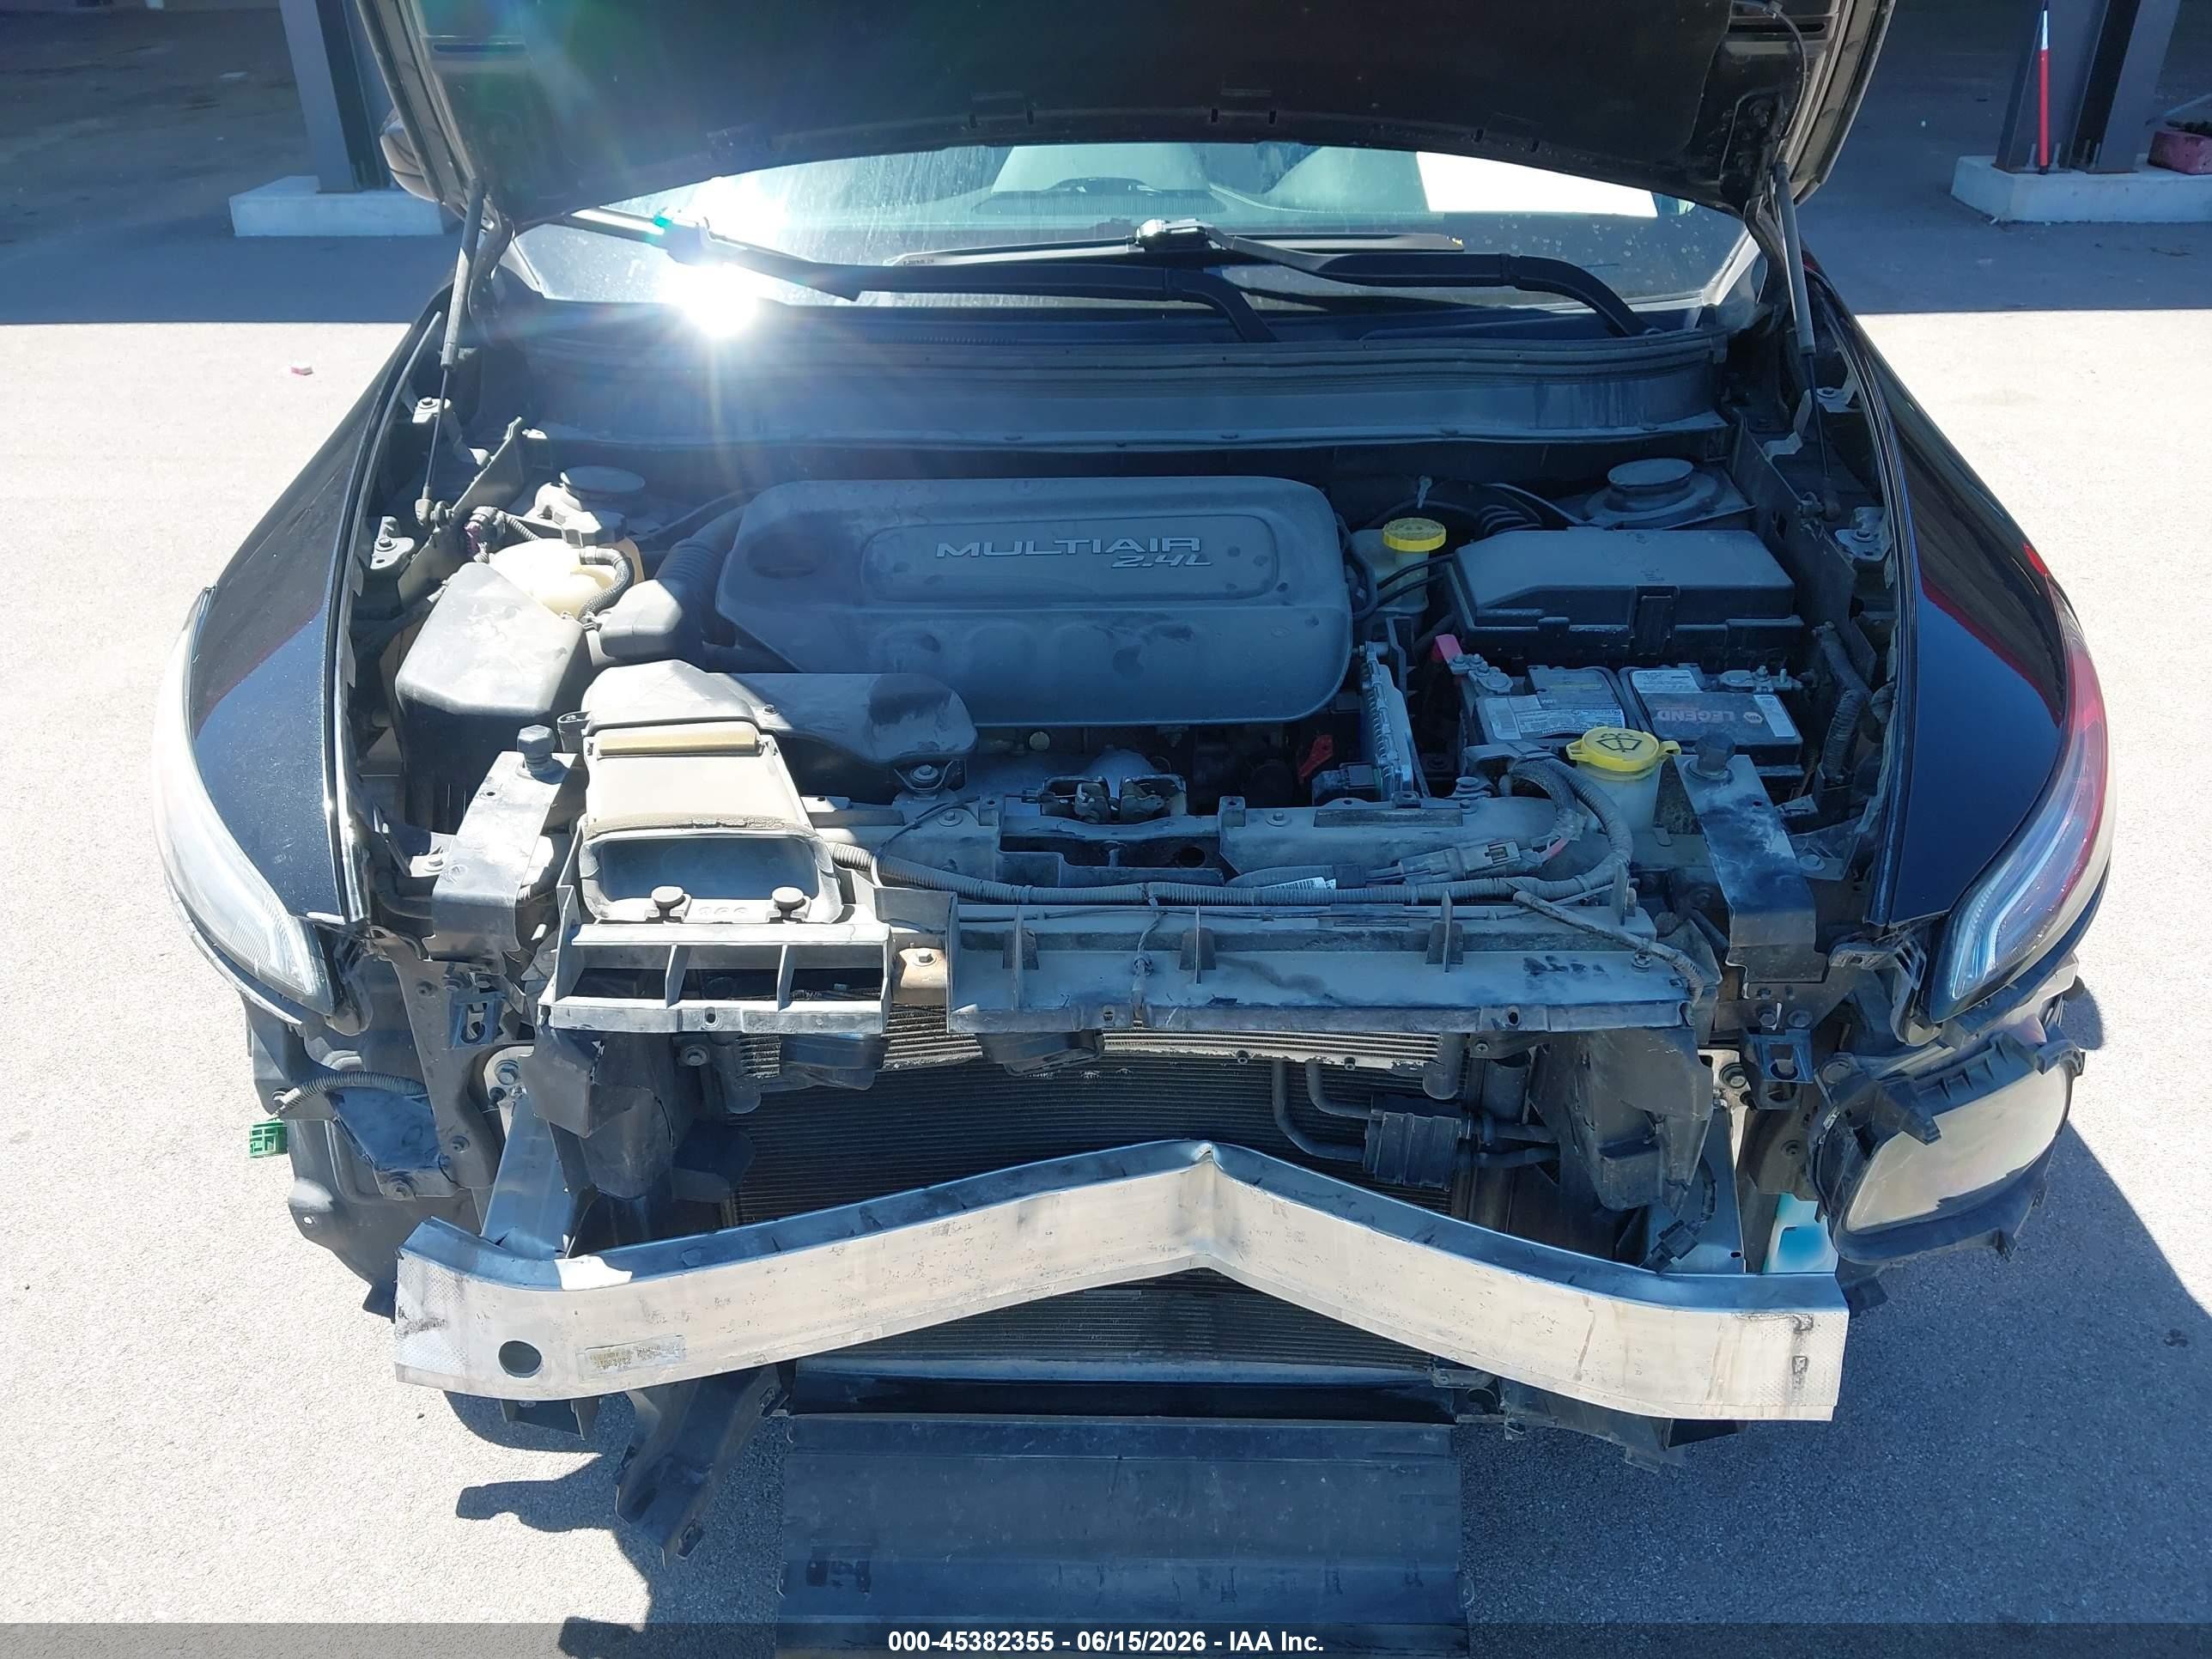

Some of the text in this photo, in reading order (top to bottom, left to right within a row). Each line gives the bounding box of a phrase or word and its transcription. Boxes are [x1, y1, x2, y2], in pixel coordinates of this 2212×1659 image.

[936, 537, 1200, 558] MULTIAIR
[1111, 554, 1212, 568] 2.4L
[1657, 709, 1735, 723] LEGEND
